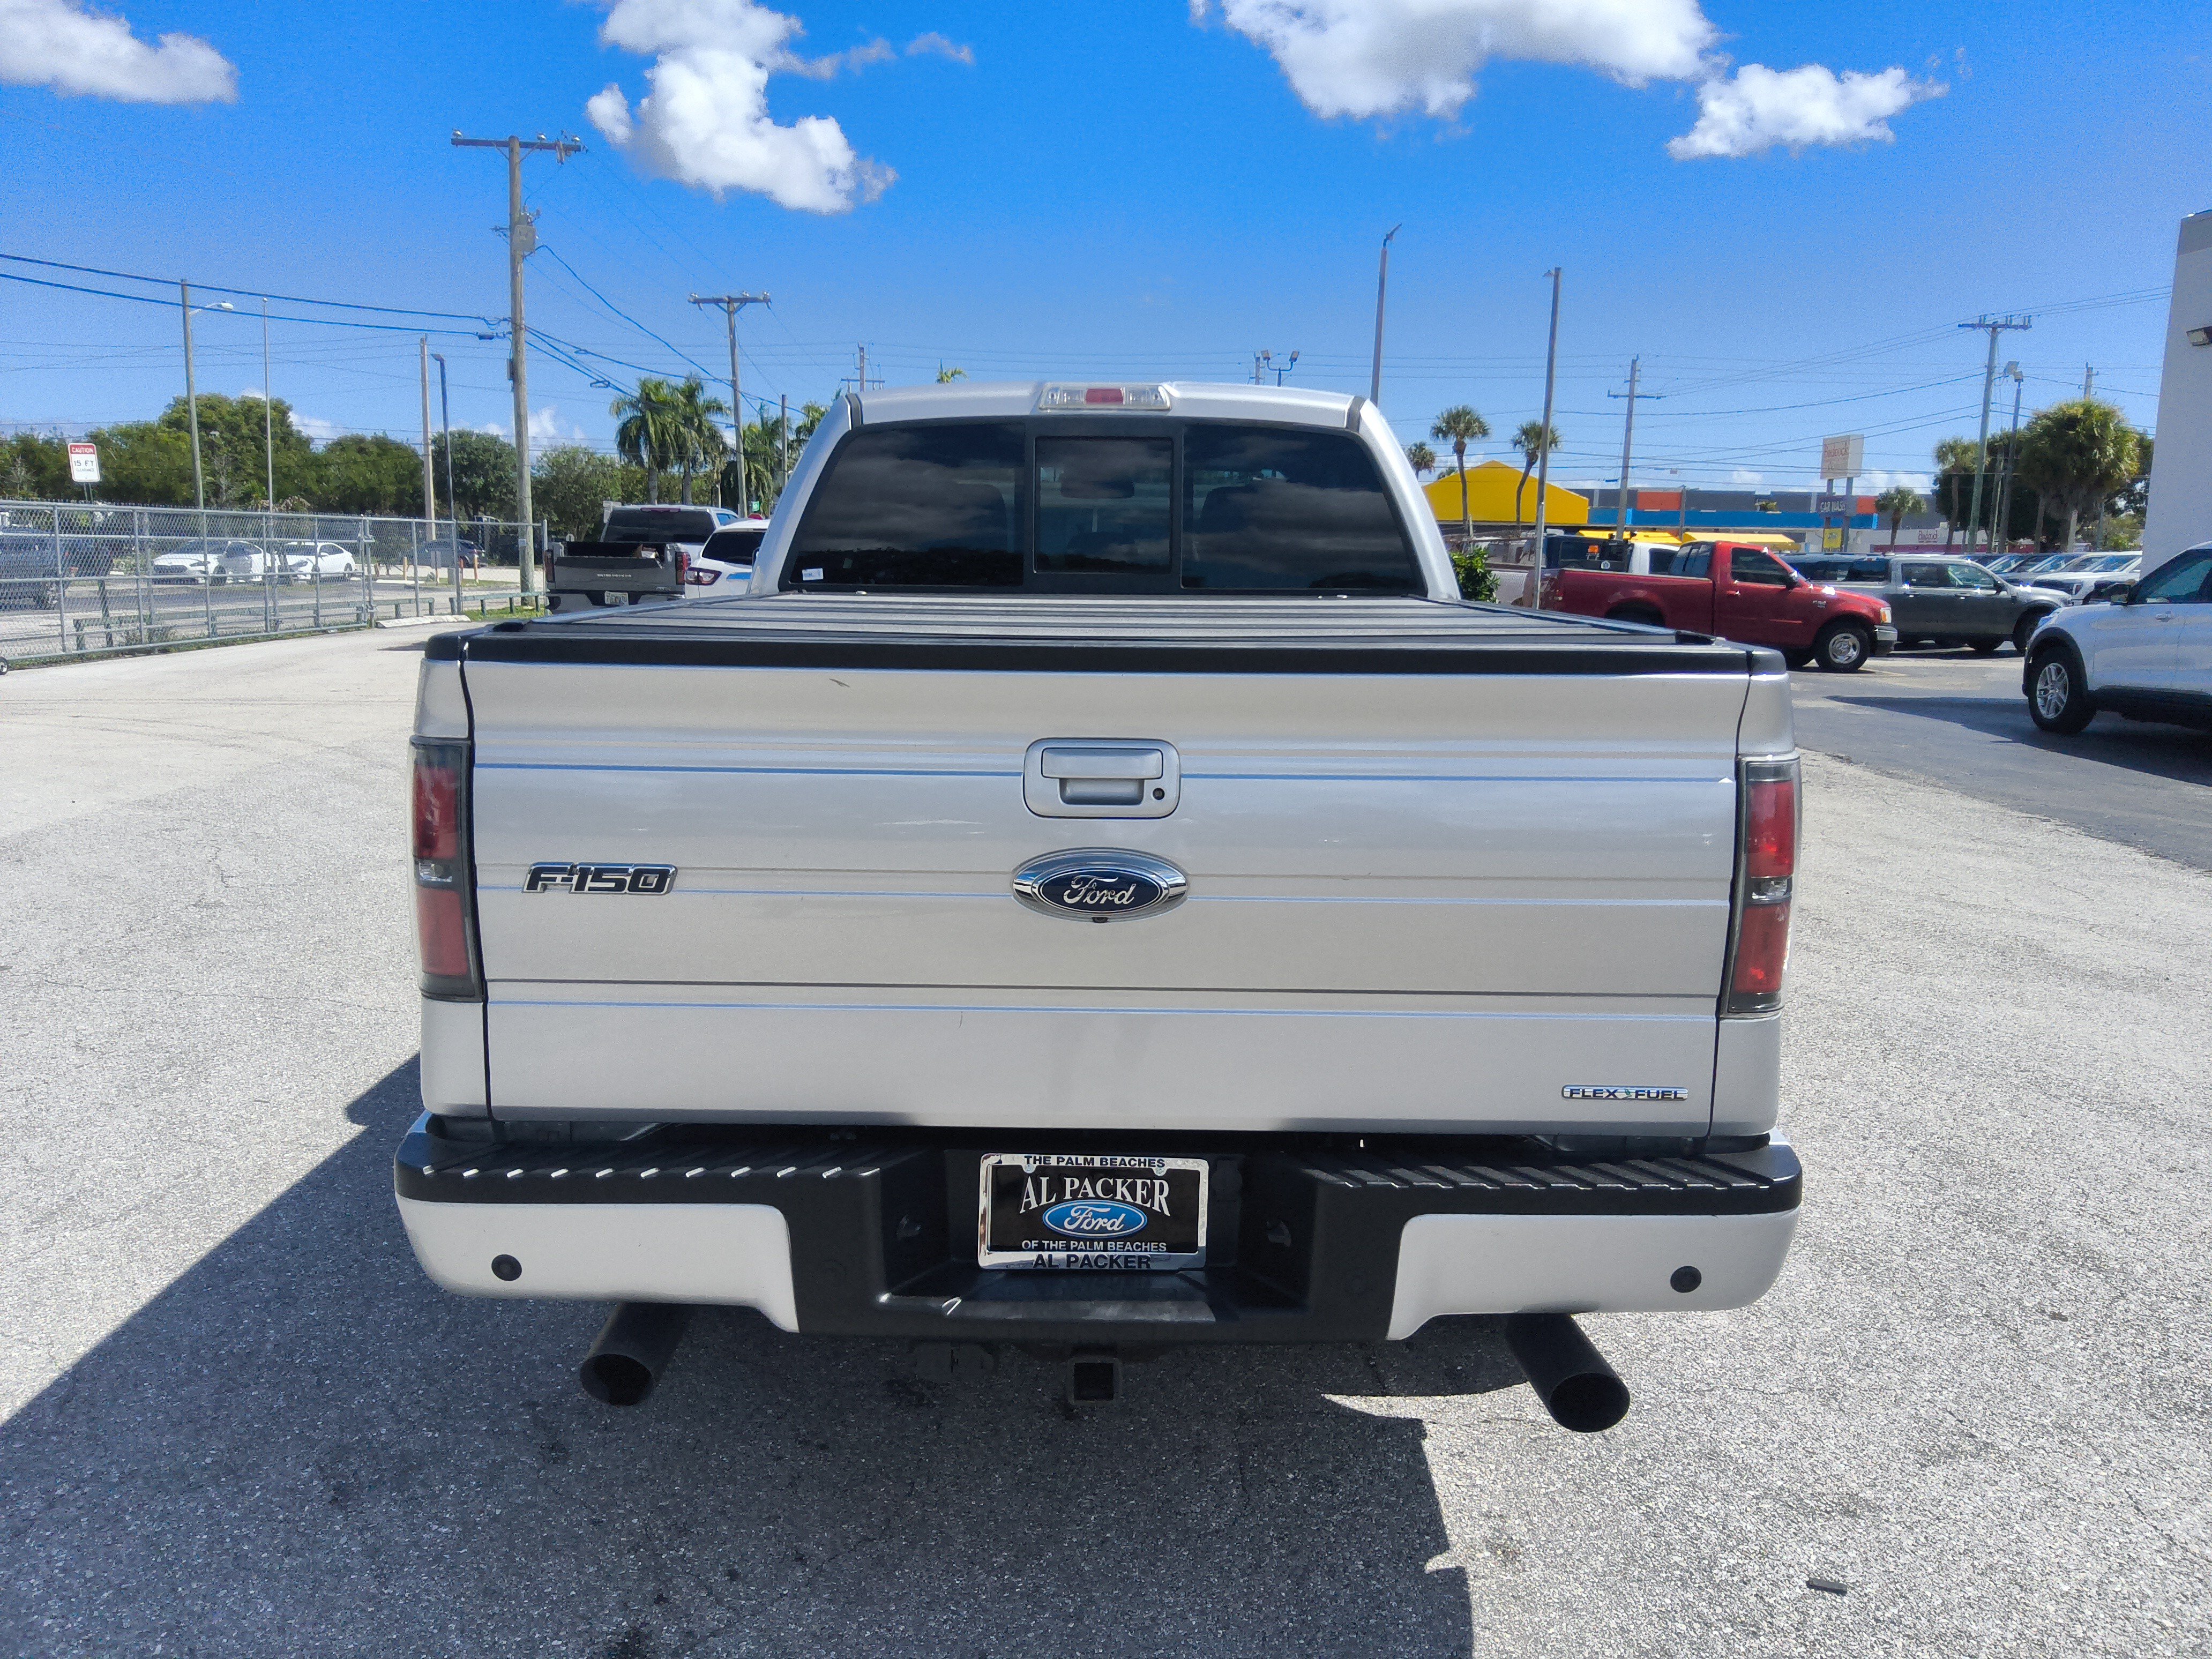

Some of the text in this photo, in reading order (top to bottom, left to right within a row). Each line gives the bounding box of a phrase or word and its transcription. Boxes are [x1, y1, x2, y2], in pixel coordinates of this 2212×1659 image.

[522, 862, 678, 895] F-150
[1063, 875, 1137, 905] Ford
[1569, 1088, 1685, 1100] FLEX FUEL
[1024, 1155, 1165, 1168] THE PALM BEACHES
[1019, 1176, 1170, 1216] AL PACKER
[1064, 1206, 1126, 1231] Ford
[1022, 1240, 1167, 1252] OF THE PALM BEACHES
[1033, 1254, 1152, 1269] AL PACKER
